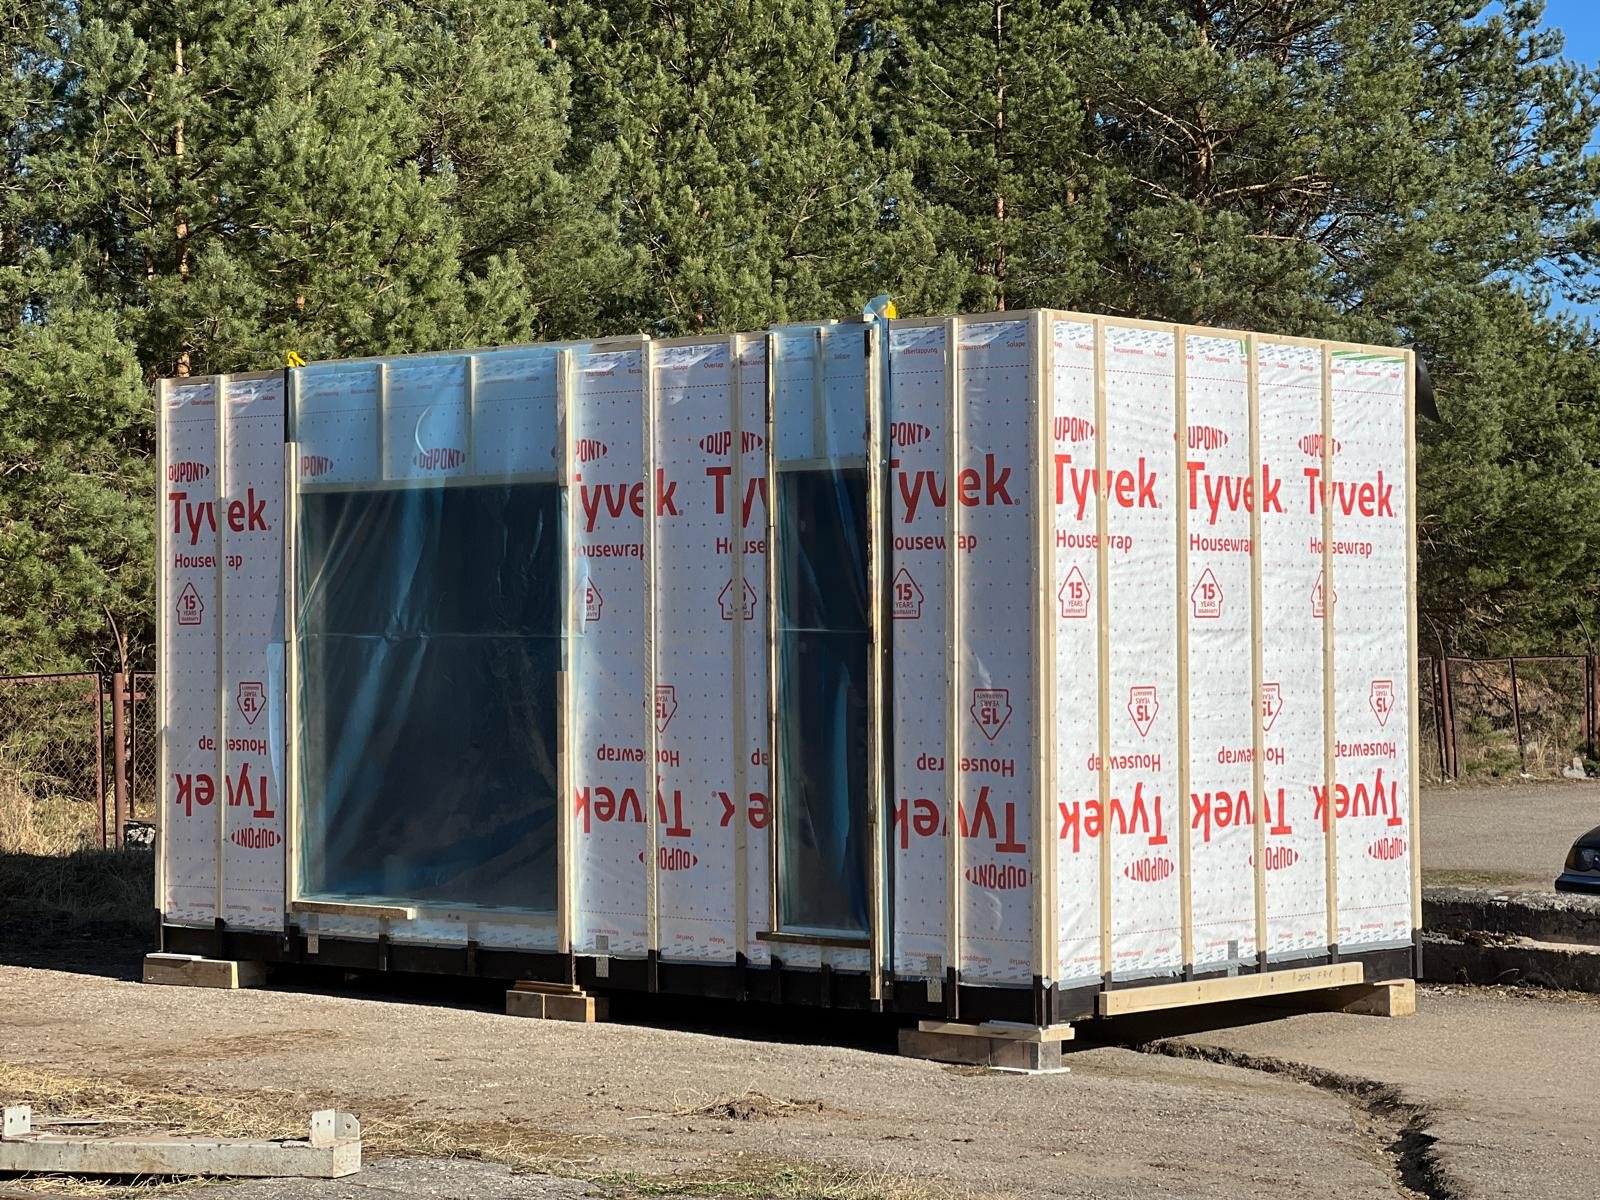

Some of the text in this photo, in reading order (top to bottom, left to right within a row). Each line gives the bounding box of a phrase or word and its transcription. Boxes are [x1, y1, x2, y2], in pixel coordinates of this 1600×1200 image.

[1007, 340, 1026, 349] Solape
[703, 361, 724, 369] Overlap
[890, 422, 924, 447] PONT
[1054, 417, 1090, 443] UPONT
[1188, 425, 1224, 450] UPONT
[576, 439, 601, 462] PONT
[706, 432, 755, 456] DUPNT
[301, 457, 328, 477] PONT
[889, 453, 1013, 523] yvek
[572, 468, 678, 533] yvek
[1056, 530, 1132, 552] Houserap
[1309, 536, 1373, 559] Hosewrap
[174, 553, 243, 570] Houseap
[895, 583, 913, 600] 15
[1068, 581, 1082, 598] 15
[1201, 583, 1215, 600] 15
[184, 595, 196, 610] 15
[244, 698, 257, 712] 15
[1136, 705, 1150, 722] 15
[1376, 698, 1388, 713] 15
[981, 707, 1000, 725] 15
[597, 744, 680, 767] Hoewrap
[917, 752, 1014, 777] Houserap
[1088, 753, 1161, 772] Housewap
[1218, 745, 1285, 766] Hosewrap
[236, 828, 275, 849] DUPONT
[657, 848, 691, 871] DUPO
[1131, 857, 1169, 882] DUPONT
[1266, 847, 1293, 871] DUPO
[972, 863, 1026, 889] DUPONT
[1009, 957, 1031, 966] Overlap
